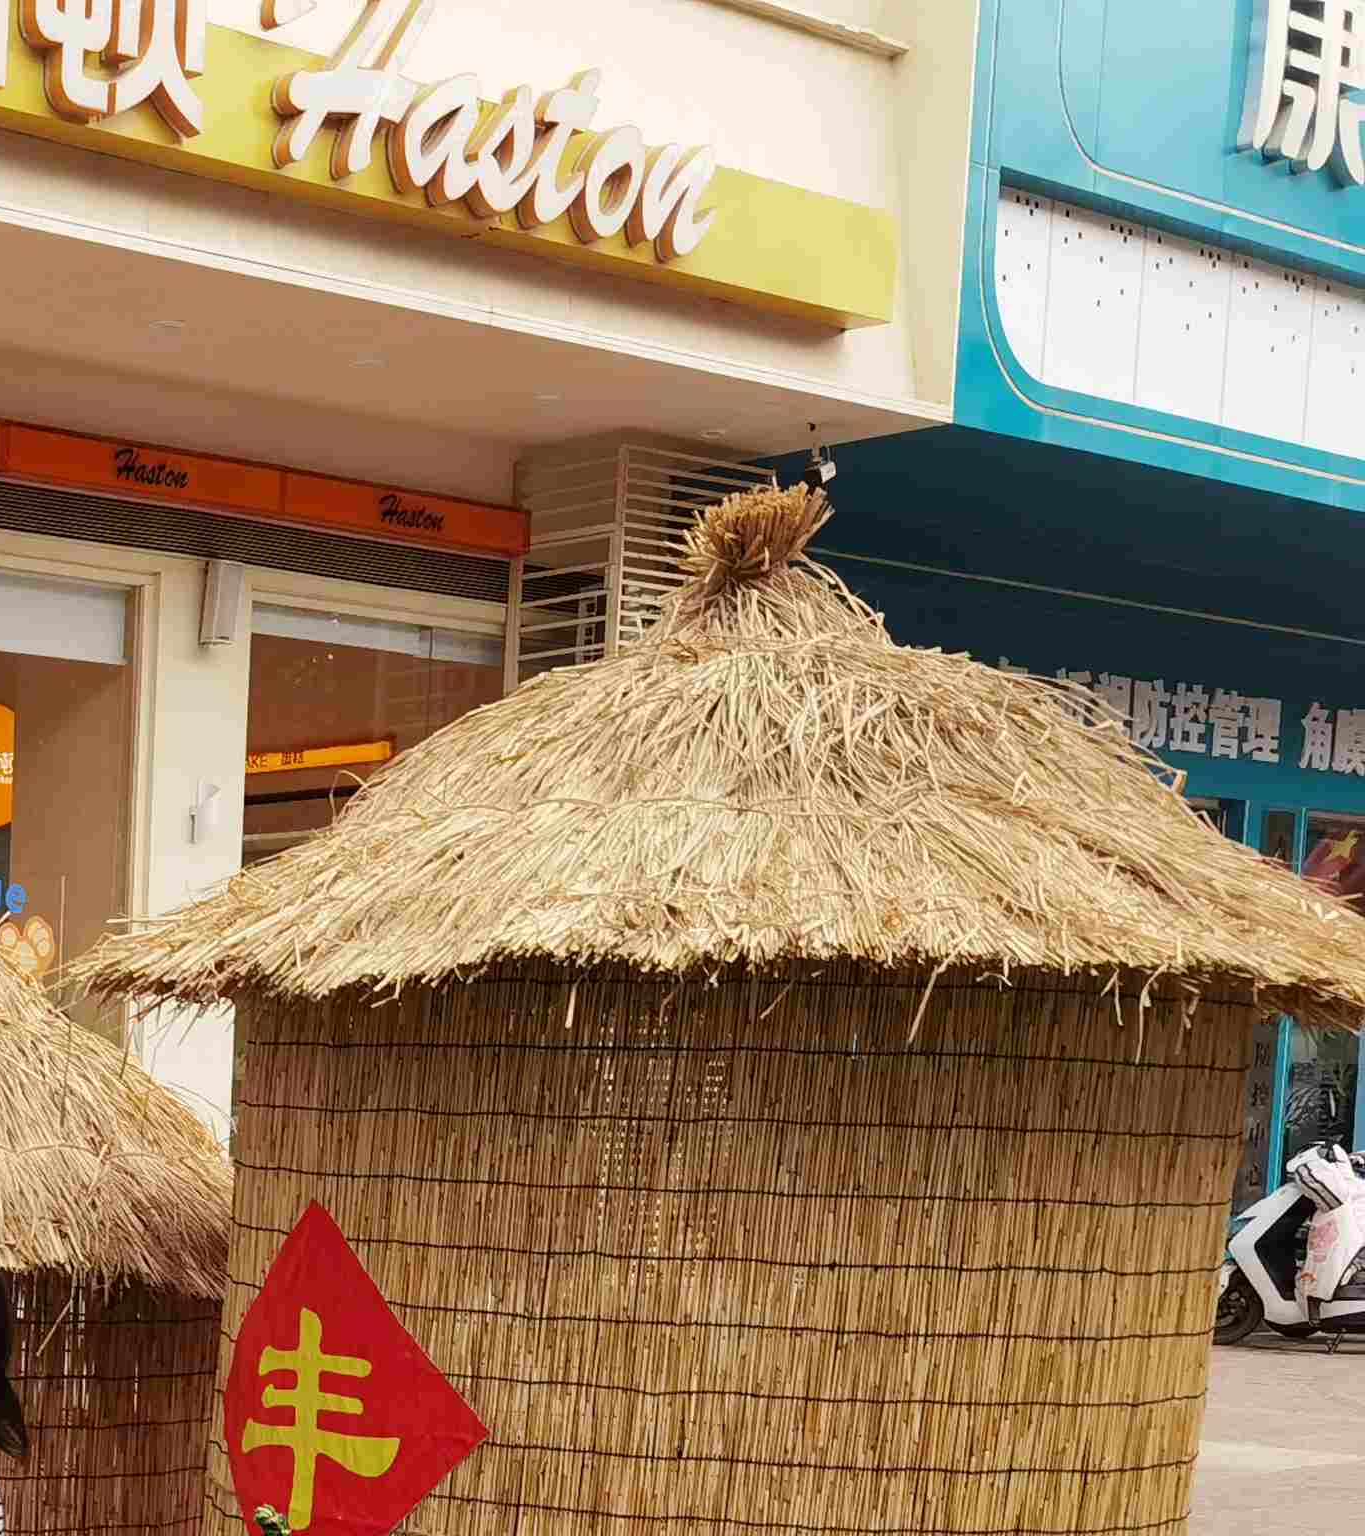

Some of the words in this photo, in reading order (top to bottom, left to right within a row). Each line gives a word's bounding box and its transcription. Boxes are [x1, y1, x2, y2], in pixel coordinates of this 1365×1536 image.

[261, 0, 717, 262] Haston
[114, 448, 190, 489] Haston
[378, 493, 446, 532] Haston
[241, 1306, 401, 1531] 丰
